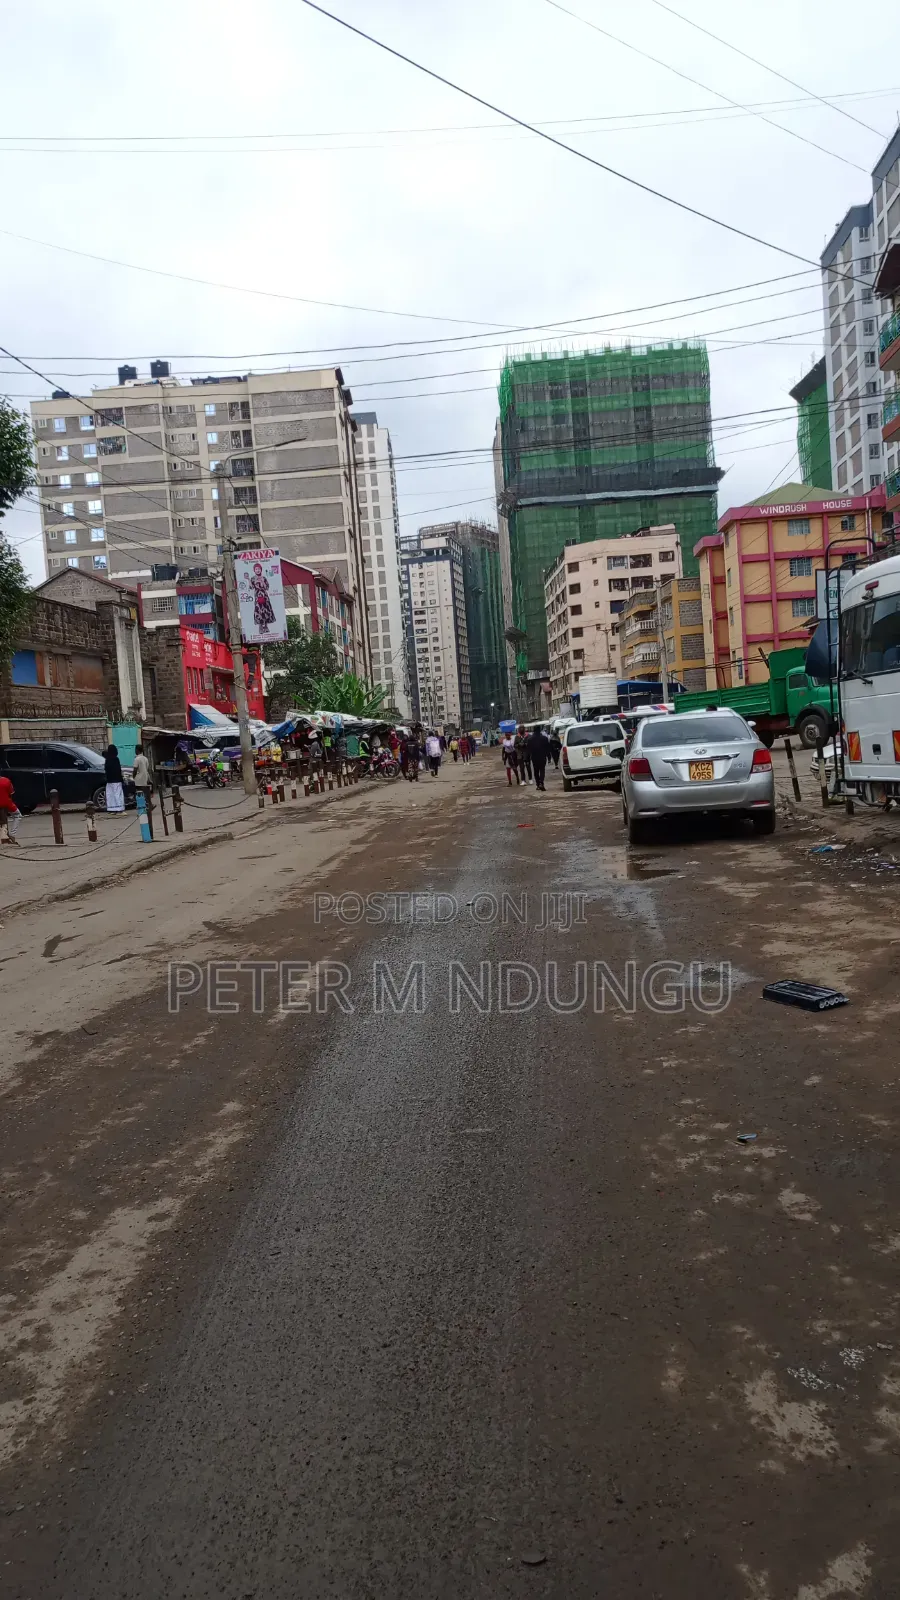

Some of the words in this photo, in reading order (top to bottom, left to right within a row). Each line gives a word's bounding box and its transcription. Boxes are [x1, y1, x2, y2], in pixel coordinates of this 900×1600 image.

[759, 504, 807, 515] WINDRUSH
[822, 499, 852, 510] HOUSE
[238, 549, 275, 560] ZAKIYA
[694, 762, 712, 772] KCZ
[691, 772, 712, 781] 495S
